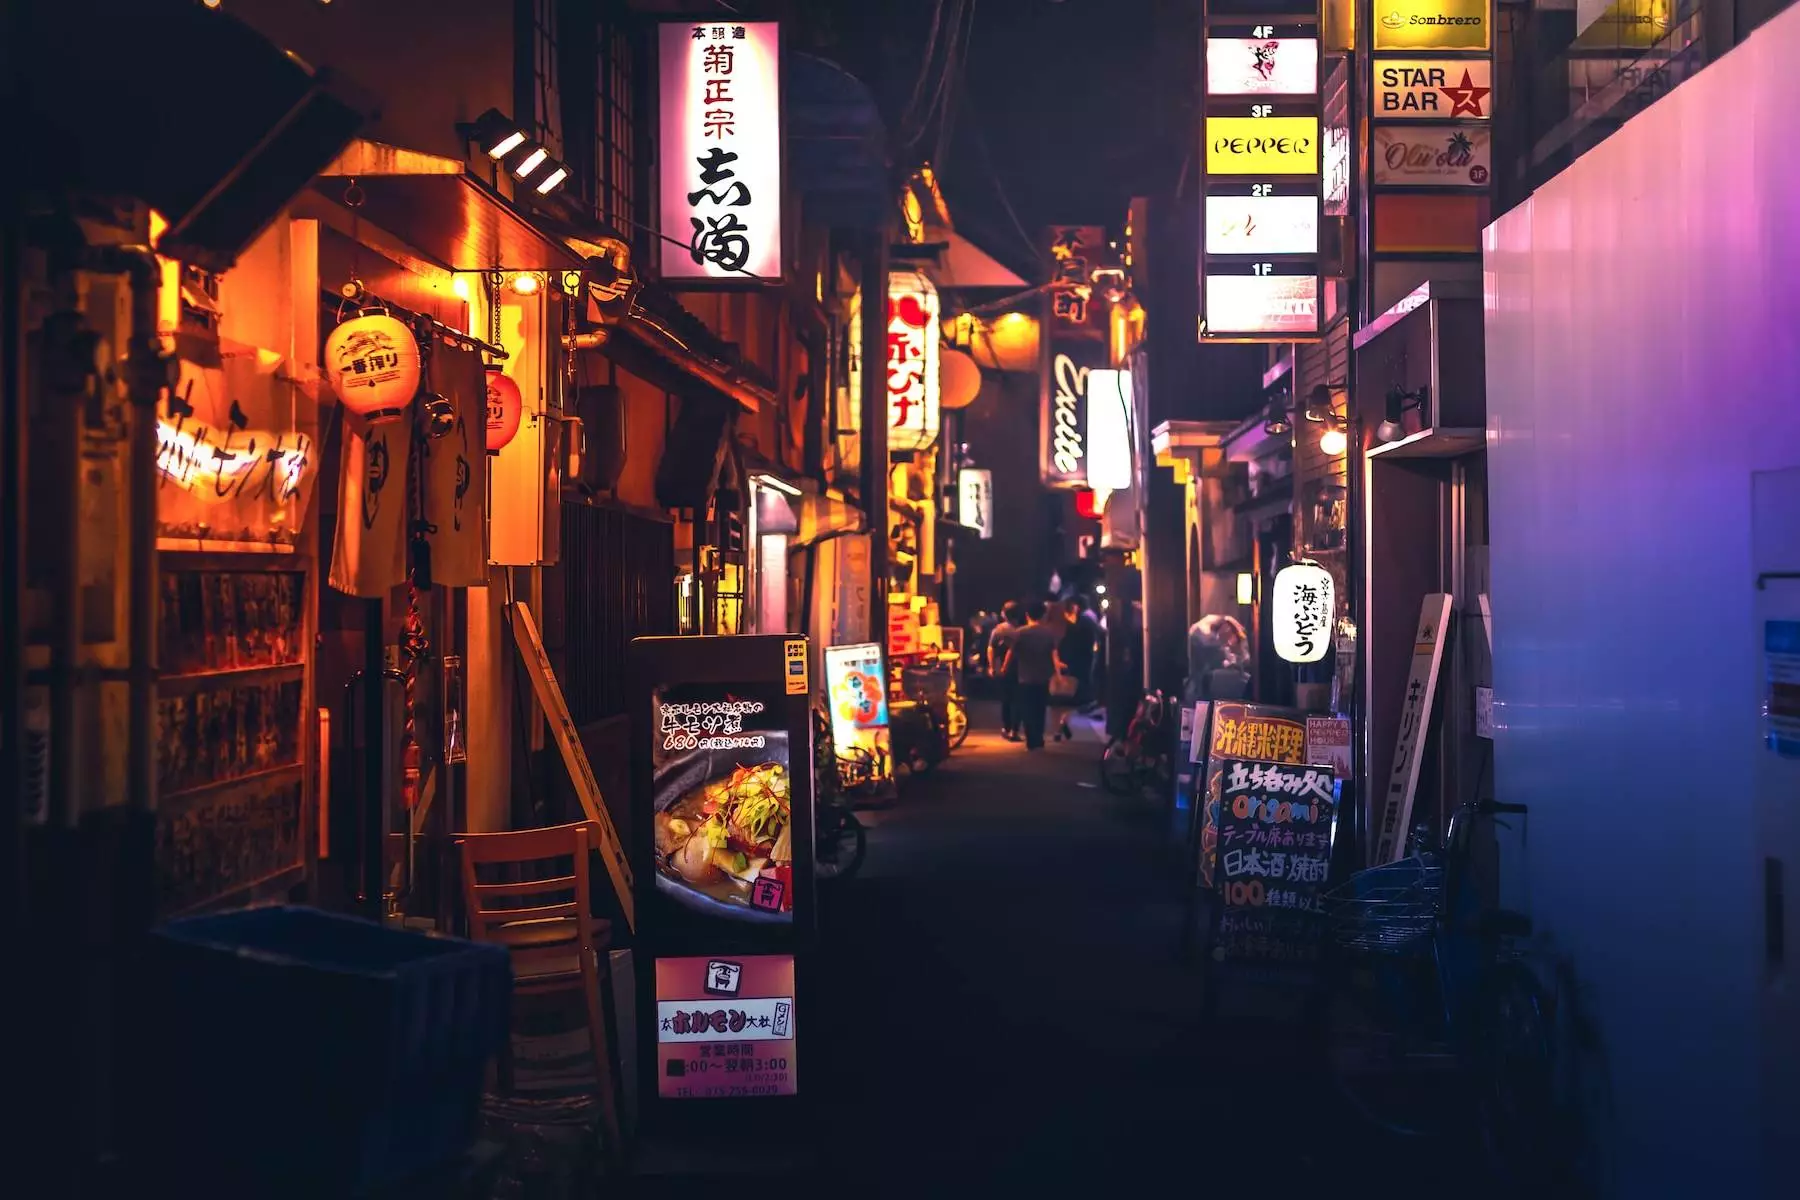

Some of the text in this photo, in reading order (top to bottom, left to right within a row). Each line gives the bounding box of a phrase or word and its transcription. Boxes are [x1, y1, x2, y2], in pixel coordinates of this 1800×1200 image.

[1408, 14, 1482, 26] Sombrero
[1252, 26, 1274, 39] 4F
[1382, 68, 1445, 88] STAR
[703, 44, 735, 140] 菊正宗
[1383, 91, 1438, 111] BAR
[1251, 105, 1273, 118] 3F
[1214, 137, 1310, 154] PEPPER
[1471, 169, 1486, 180] 3F
[1251, 184, 1273, 197] 2F
[1251, 263, 1273, 276] 1F
[1054, 353, 1090, 473] Excite
[1293, 584, 1319, 656] 海ぶどう
[1216, 718, 1304, 764] 沖縄料理
[1225, 762, 1334, 804] 立ち呑み処
[700, 1044, 754, 1058] 営業時間
